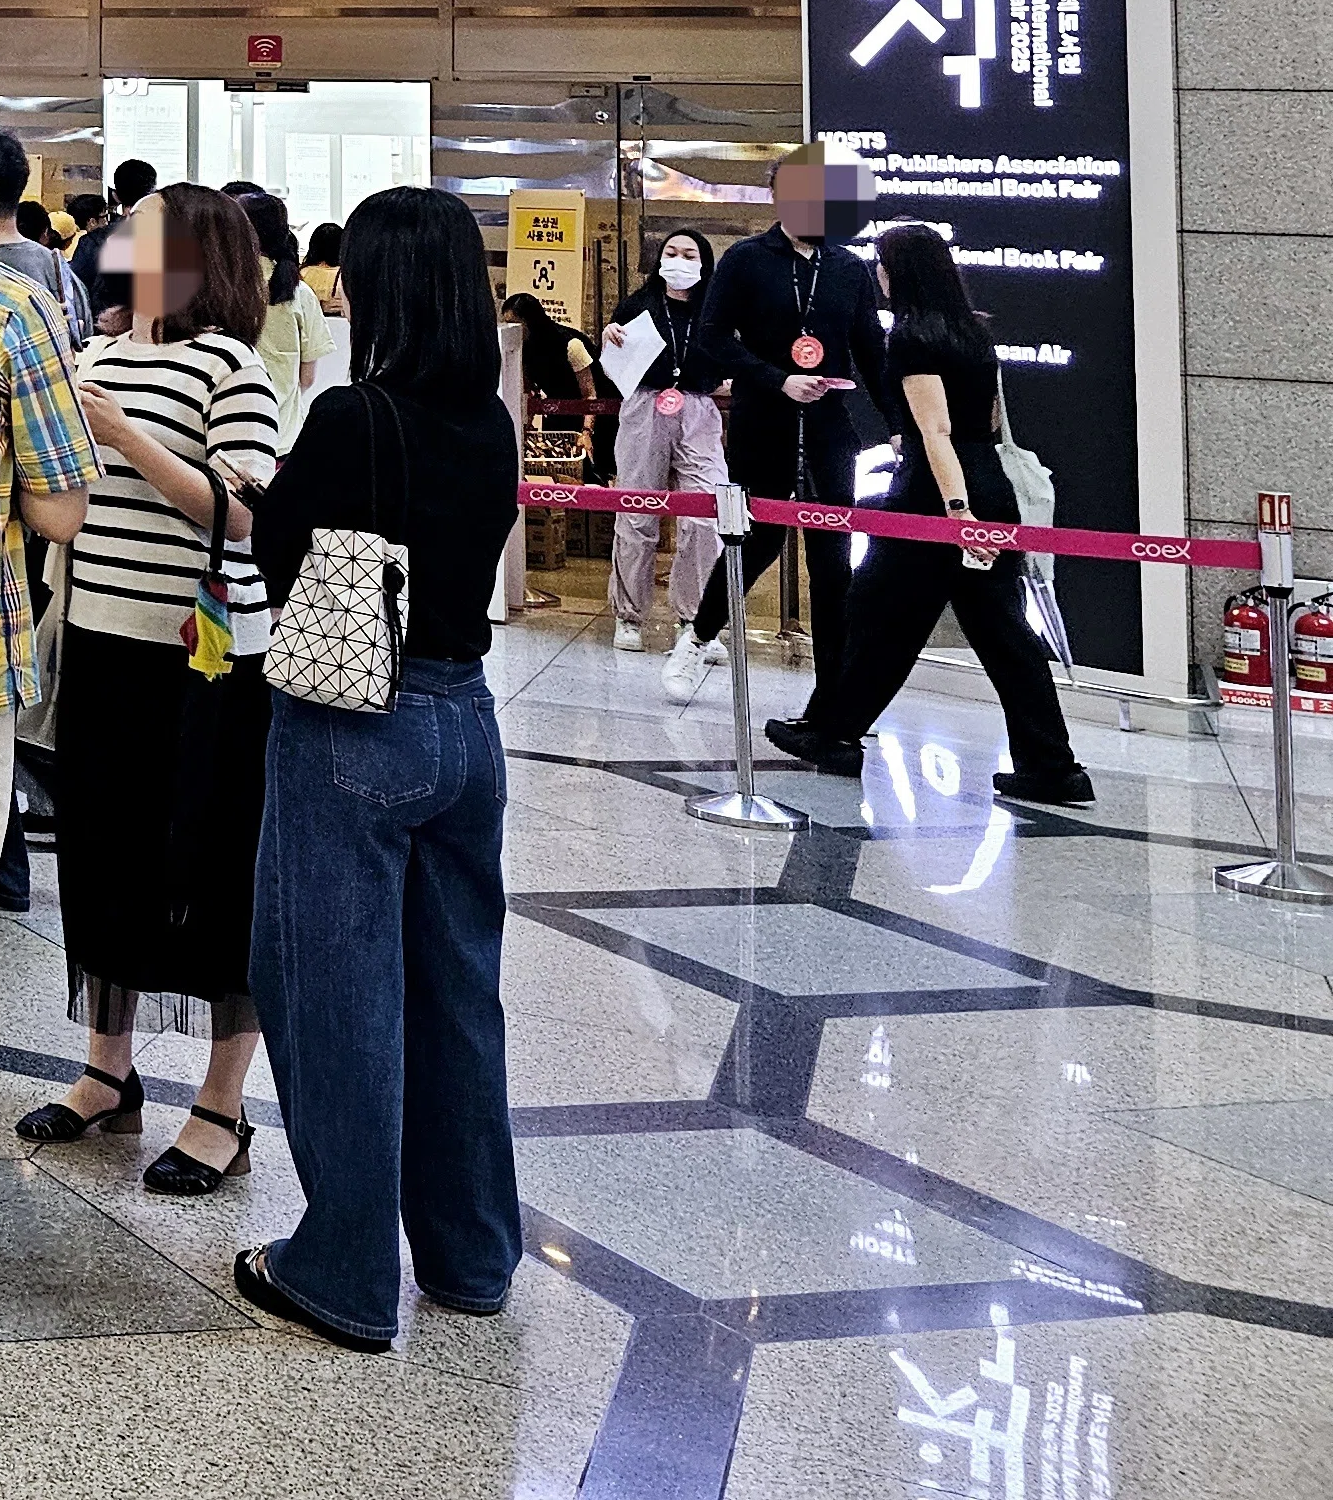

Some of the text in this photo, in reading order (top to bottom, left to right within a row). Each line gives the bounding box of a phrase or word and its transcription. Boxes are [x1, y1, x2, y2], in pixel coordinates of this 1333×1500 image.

[1011, 21, 1031, 74] 2025
[817, 130, 887, 150] HOSTS
[887, 153, 994, 174] Publishers
[994, 154, 1121, 176] Association
[874, 175, 1103, 199] International Book Fair
[532, 216, 559, 229] 초상권
[527, 230, 564, 243] 사용 안내
[1004, 248, 1060, 269] Book
[1060, 249, 1105, 271] Fair
[993, 344, 1072, 365] ean Air
[529, 487, 579, 504] coex
[619, 493, 670, 511] coex
[797, 509, 853, 529] coex
[960, 526, 1018, 546] coex
[1131, 540, 1191, 560] coex
